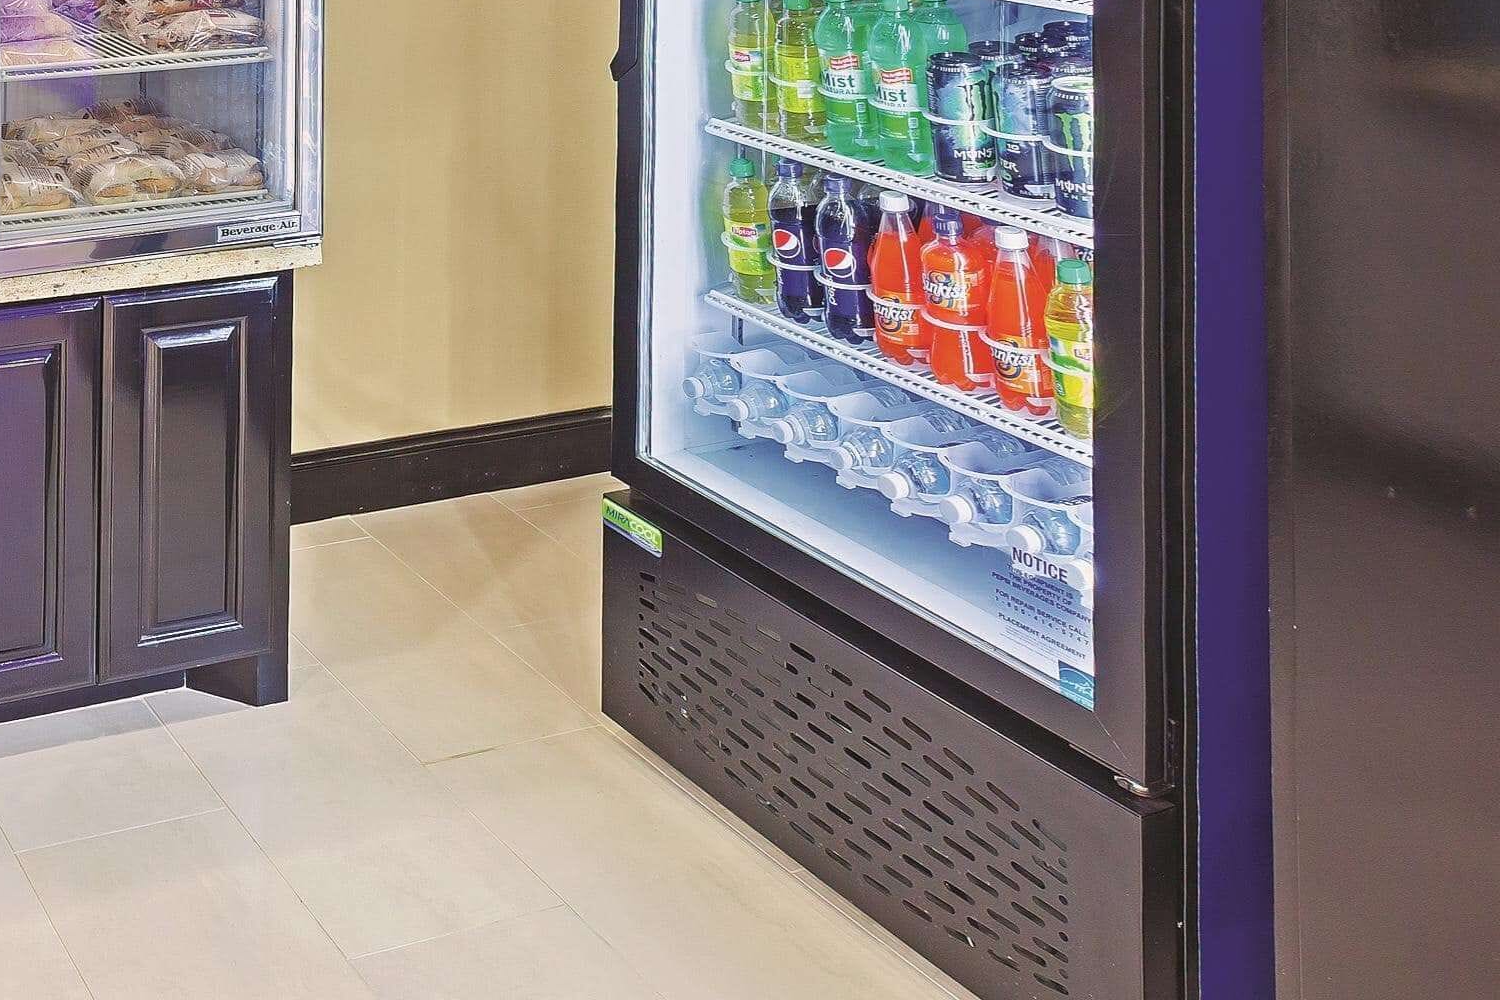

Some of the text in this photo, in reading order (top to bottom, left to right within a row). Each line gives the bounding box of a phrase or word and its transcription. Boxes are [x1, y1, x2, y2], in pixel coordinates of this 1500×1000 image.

[992, 347, 1035, 367] unkist
[1012, 546, 1068, 585] NOTICE
[998, 612, 1040, 637] PLACEMENT
[1041, 634, 1086, 659] AGREEMENT
[1068, 624, 1089, 638] CALL
